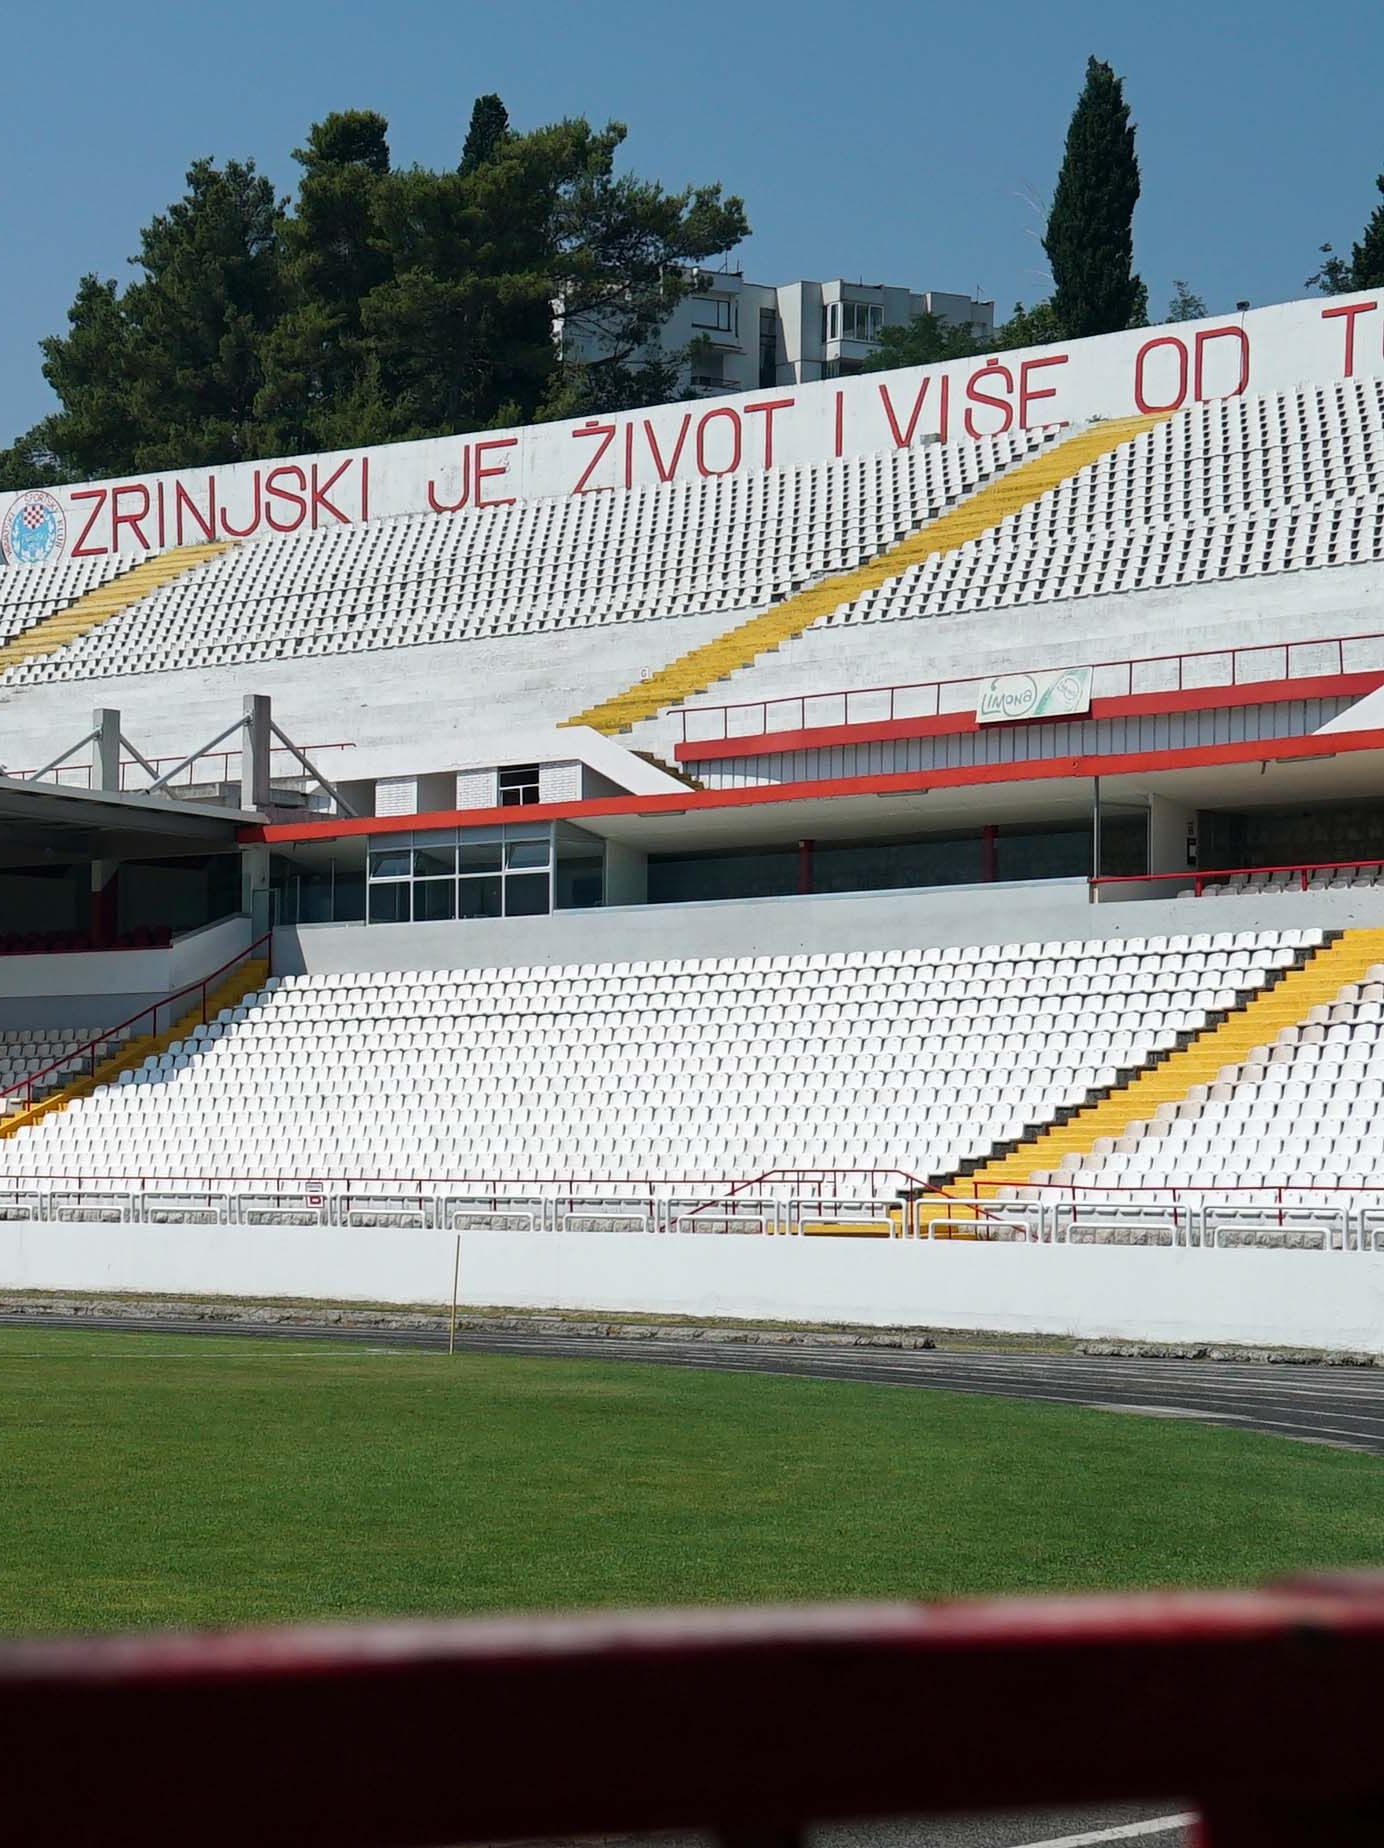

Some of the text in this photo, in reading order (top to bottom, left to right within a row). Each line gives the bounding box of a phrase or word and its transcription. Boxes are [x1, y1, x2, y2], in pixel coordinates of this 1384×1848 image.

[70, 457, 369, 557] ZRINJSKI
[428, 438, 518, 513] JE
[572, 398, 795, 495] ŽIVOT
[835, 390, 844, 457] I
[879, 354, 1069, 448] VIŠE
[1134, 326, 1250, 414] OD
[1321, 301, 1384, 378] T
